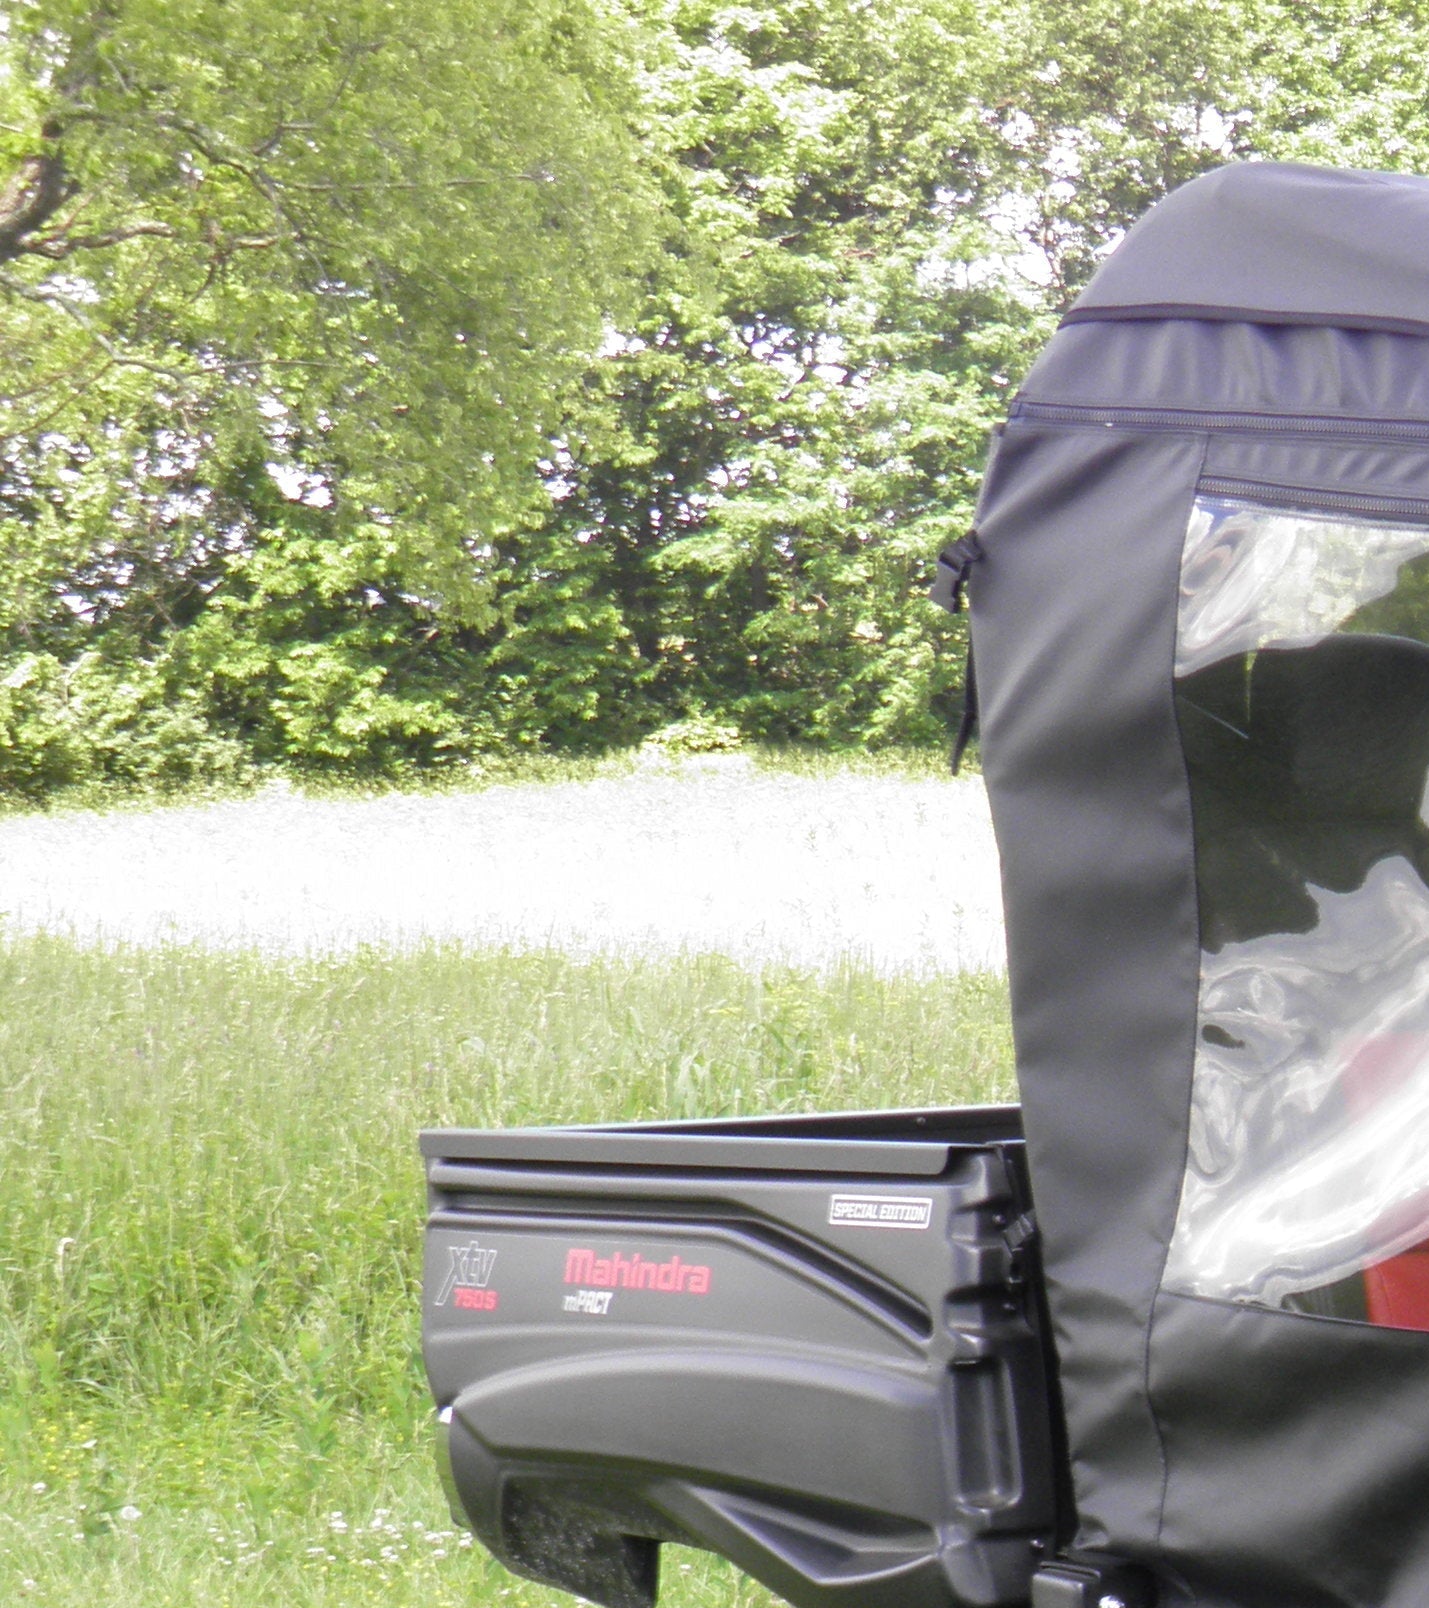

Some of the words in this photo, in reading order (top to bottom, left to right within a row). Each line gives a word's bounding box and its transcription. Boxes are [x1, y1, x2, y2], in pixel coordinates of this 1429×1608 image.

[833, 1203, 878, 1219] SPECIAL
[880, 1204, 928, 1221] EDITION
[563, 1248, 711, 1294] Mahindra
